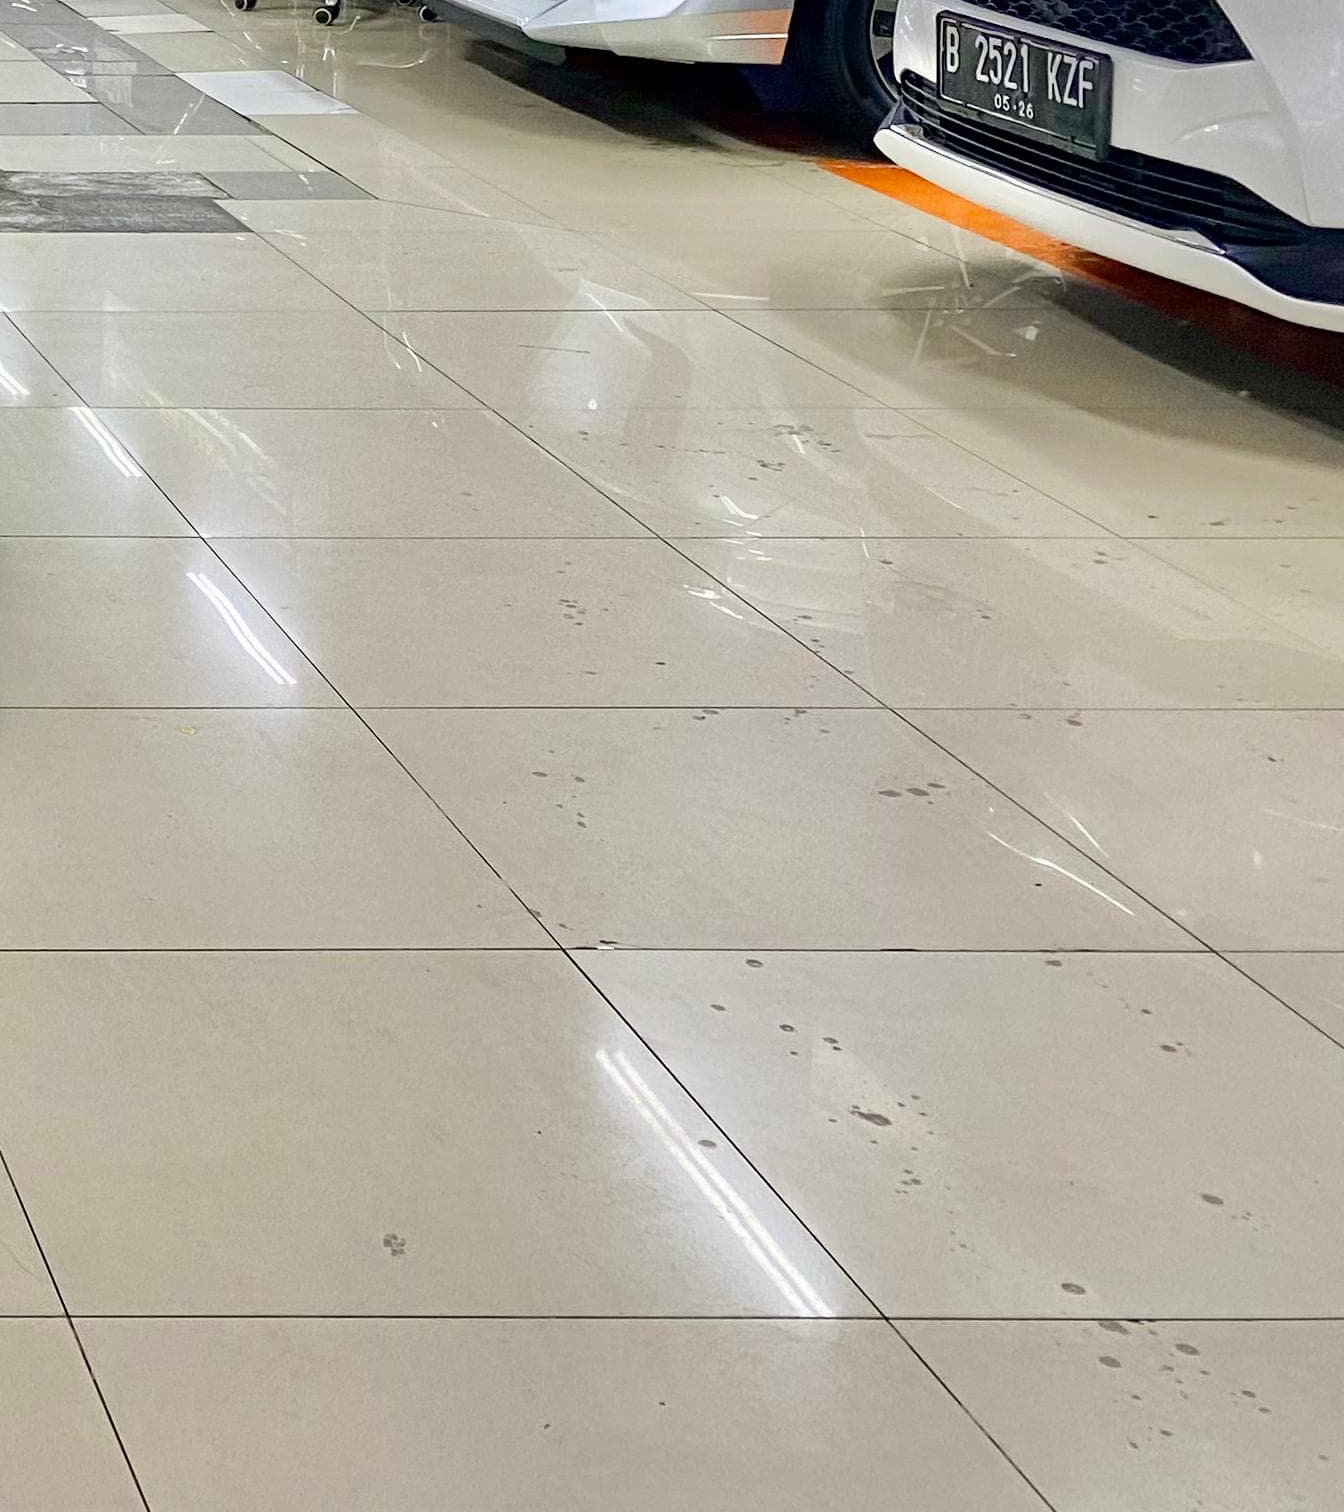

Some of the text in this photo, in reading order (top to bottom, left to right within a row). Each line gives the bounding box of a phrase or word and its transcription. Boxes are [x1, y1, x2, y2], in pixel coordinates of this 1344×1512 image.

[946, 25, 1094, 109] B 2521 KZF
